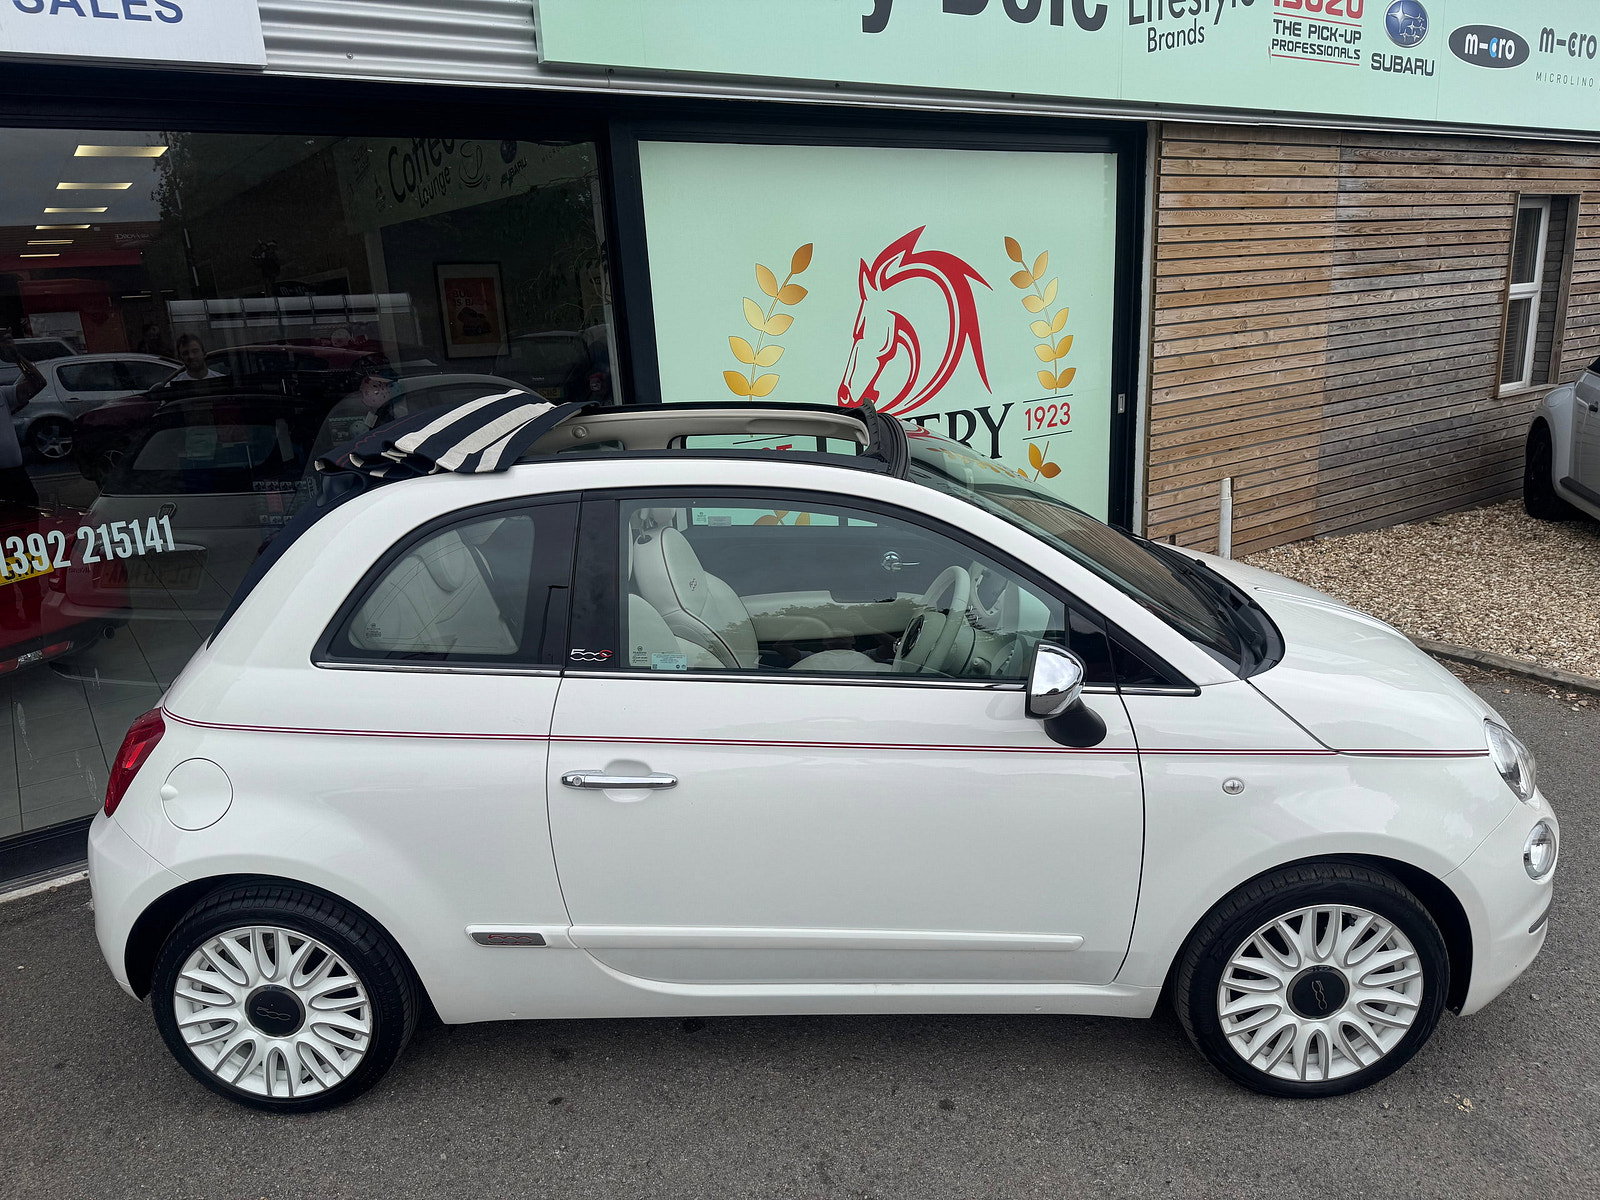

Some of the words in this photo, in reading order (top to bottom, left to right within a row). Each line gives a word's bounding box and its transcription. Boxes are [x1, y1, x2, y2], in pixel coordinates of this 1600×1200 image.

[1147, 18, 1206, 53] Brands
[1272, 18, 1302, 38] THE
[1308, 23, 1362, 45] PICK-UP
[1271, 38, 1361, 60] PROFESSIONALS
[1370, 52, 1436, 77] SUBARU
[1535, 71, 1594, 88] MICROLINO
[418, 166, 451, 209] Lounge
[1024, 402, 1072, 431] 1923
[77, 514, 176, 564] 215141
